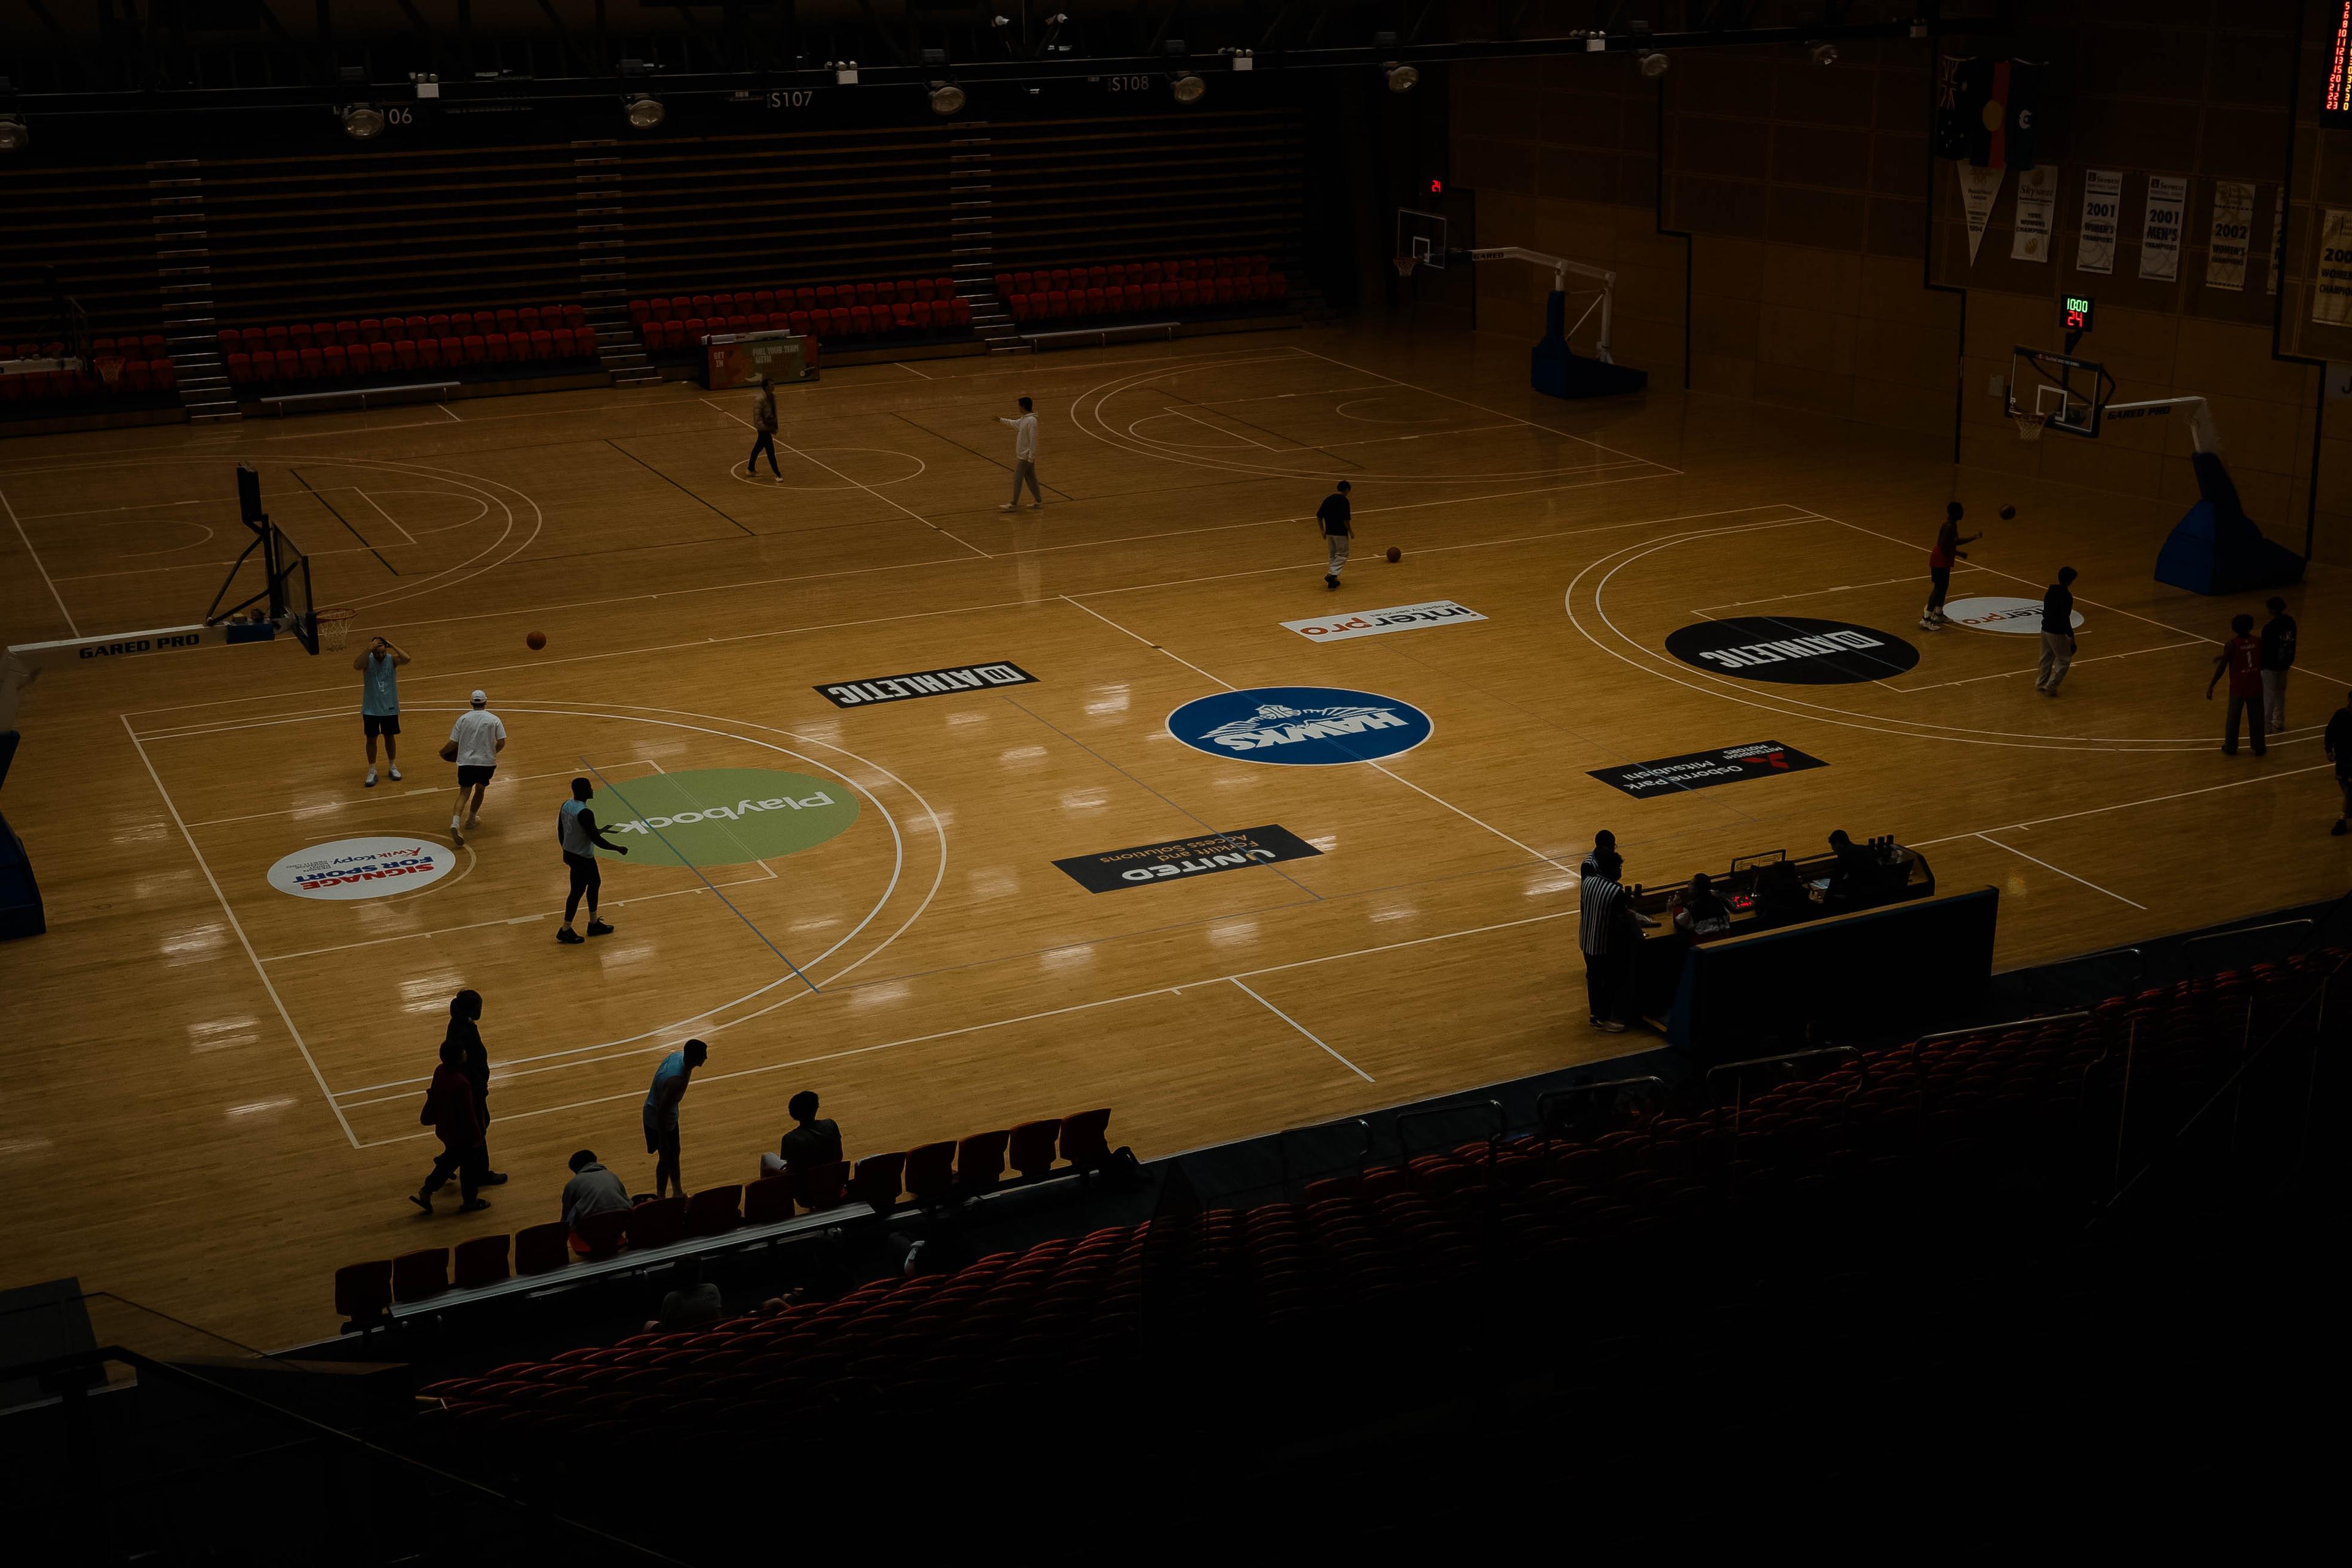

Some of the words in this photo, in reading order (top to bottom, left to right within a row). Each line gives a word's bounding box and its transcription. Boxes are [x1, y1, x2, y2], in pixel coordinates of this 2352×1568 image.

[2343, 10, 2349, 20] 6
[2342, 20, 2348, 28] 8
[2338, 29, 2347, 37] 10
[2336, 47, 2345, 56] 12
[2333, 65, 2342, 74] 15
[1112, 76, 1149, 91] S108
[2329, 74, 2341, 83] 20
[771, 91, 813, 108] S107
[2327, 92, 2339, 100] 22
[2326, 101, 2339, 110] 23
[1431, 179, 1441, 193] 24
[2086, 203, 2116, 217] 2001
[2149, 209, 2179, 225] 2001
[2146, 226, 2178, 241] MEN'S
[2215, 223, 2247, 239] 2002
[2324, 247, 2352, 263] 200
[2067, 298, 2088, 313] 10:00
[2067, 311, 2083, 328] 24
[1962, 608, 2045, 625] terpro
[79, 639, 151, 659] GARED
[157, 633, 200, 649] PRO
[1214, 711, 1410, 751] HAWKS
[1722, 744, 1768, 755] MOTORS
[1722, 745, 1784, 760] MITSUBISHI
[1622, 760, 1716, 780] Mitsubishi
[1667, 765, 1744, 782] Osborne
[1623, 778, 1670, 790] Park
[614, 791, 836, 835] Playbook
[1187, 834, 1248, 848] Access
[1194, 840, 1259, 856] Forklift
[333, 854, 376, 865] Kopy
[1099, 844, 1184, 863] Solutions
[1157, 850, 1193, 862] and
[381, 856, 434, 868] FOR
[1121, 850, 1276, 881] UNITED
[293, 864, 378, 883] SPORT
[300, 863, 435, 890] SIGNAGE
